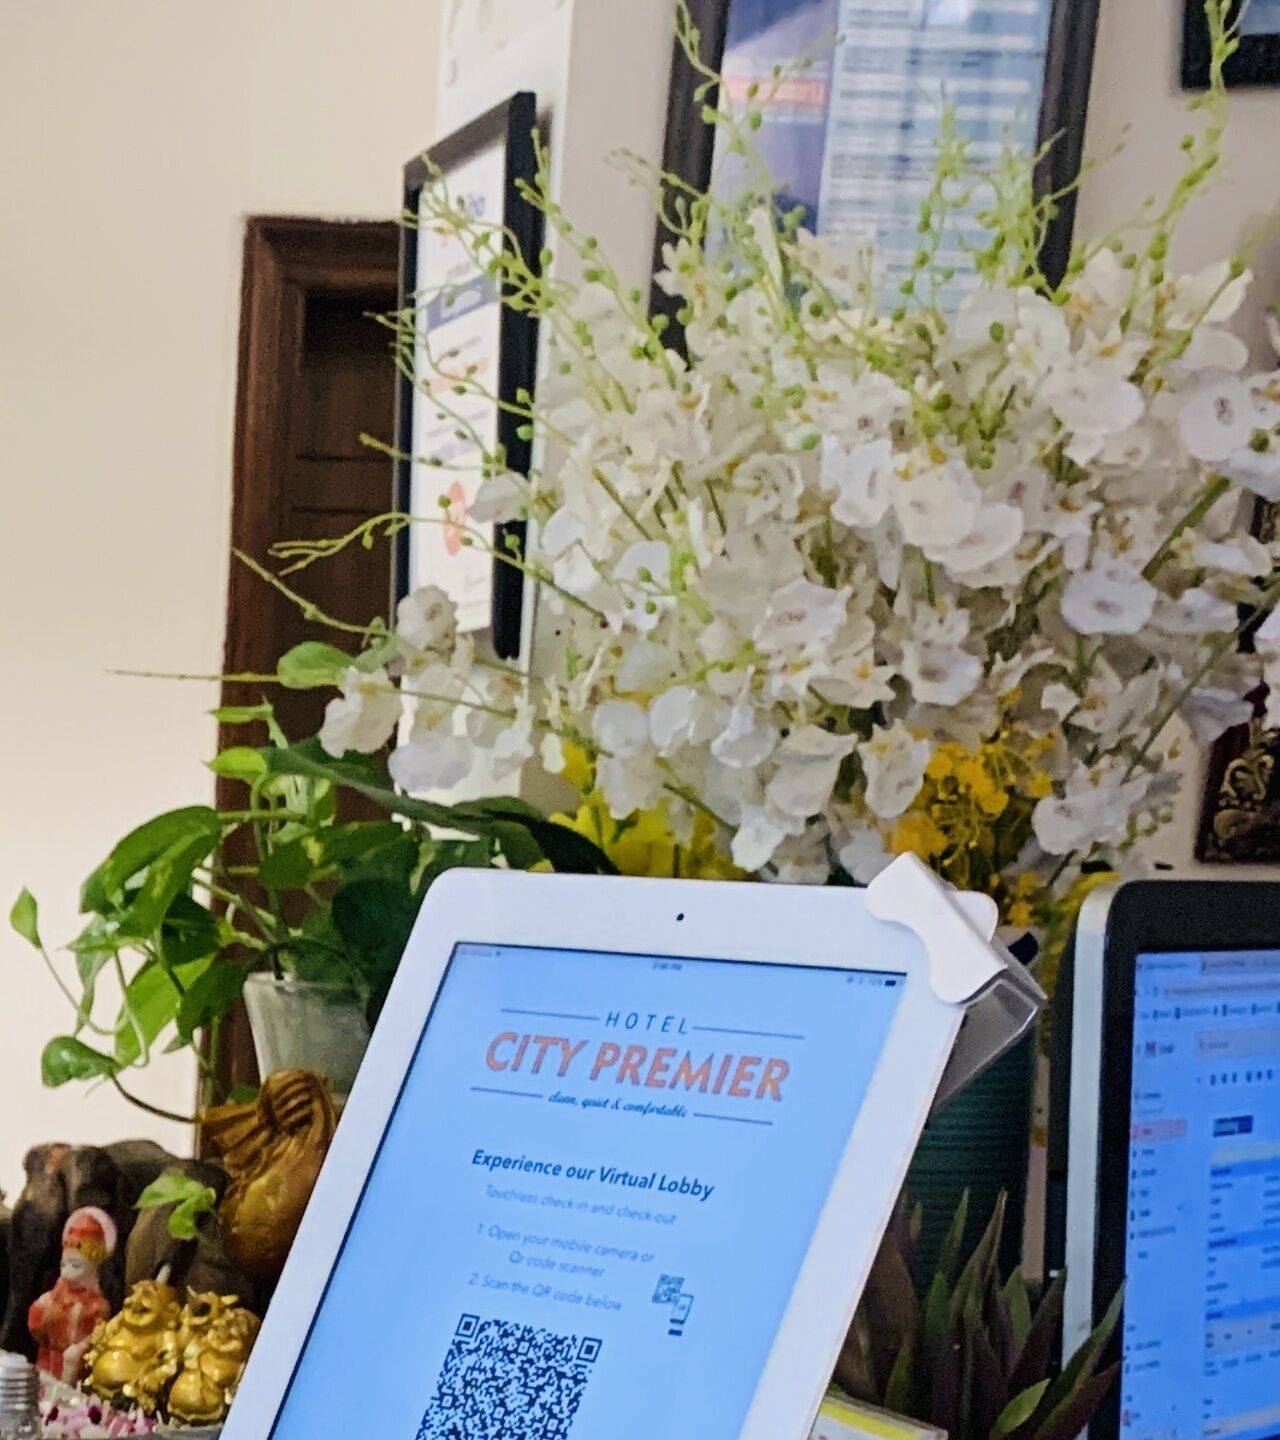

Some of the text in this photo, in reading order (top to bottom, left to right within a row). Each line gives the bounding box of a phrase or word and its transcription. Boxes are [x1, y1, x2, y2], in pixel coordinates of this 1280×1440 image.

[604, 1010, 689, 1035] HOTEL
[485, 1031, 791, 1102] CITY PREMIER
[471, 1149, 715, 1202] Experience our Virtual Lobby
[485, 1184, 539, 1205] Touchless
[591, 1203, 615, 1216] and
[488, 1224, 520, 1241] Open
[522, 1234, 548, 1246] your
[551, 1237, 592, 1253] mobile
[594, 1245, 639, 1262] camera
[640, 1253, 655, 1264] or
[526, 1255, 557, 1271] code
[559, 1262, 605, 1278] scanner
[482, 1274, 509, 1290] Scan
[511, 1281, 529, 1295] the
[532, 1283, 552, 1298] QR
[553, 1290, 584, 1305] code
[585, 1294, 623, 1312] below
